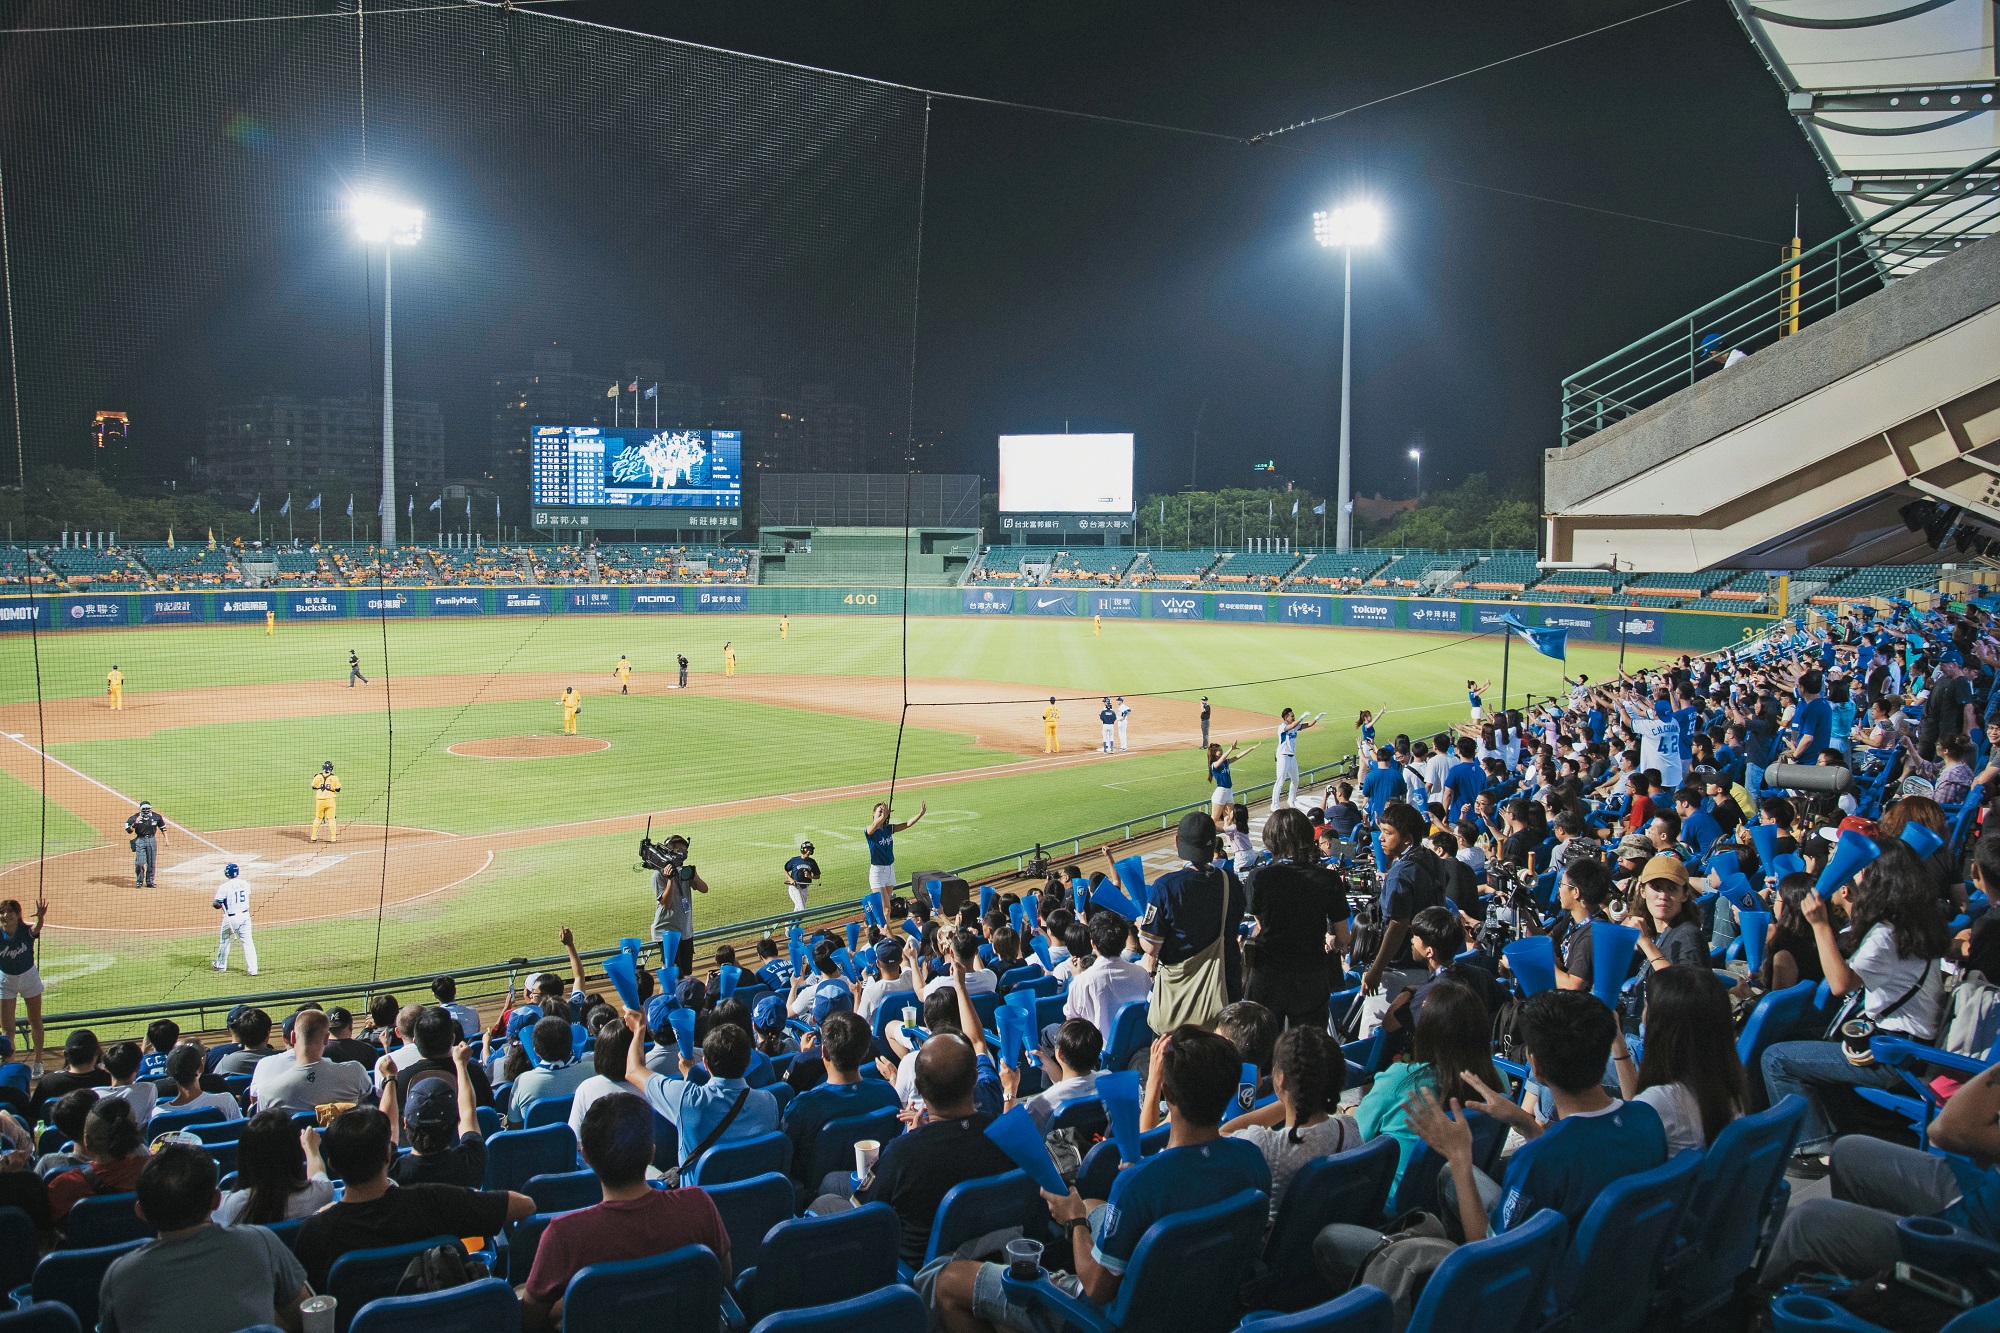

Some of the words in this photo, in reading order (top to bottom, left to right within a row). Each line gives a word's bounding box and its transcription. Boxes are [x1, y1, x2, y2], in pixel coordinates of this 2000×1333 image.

[435, 597, 478, 606] FamilyMart
[637, 595, 676, 603] momo
[843, 594, 877, 605] 400
[1160, 597, 1196, 608] vivo
[296, 603, 337, 613] Buckskin
[1352, 605, 1388, 615] tokuyo
[1657, 735, 1678, 755] 42
[234, 890, 246, 904] 15
[765, 958, 794, 974] C.T.WAN
